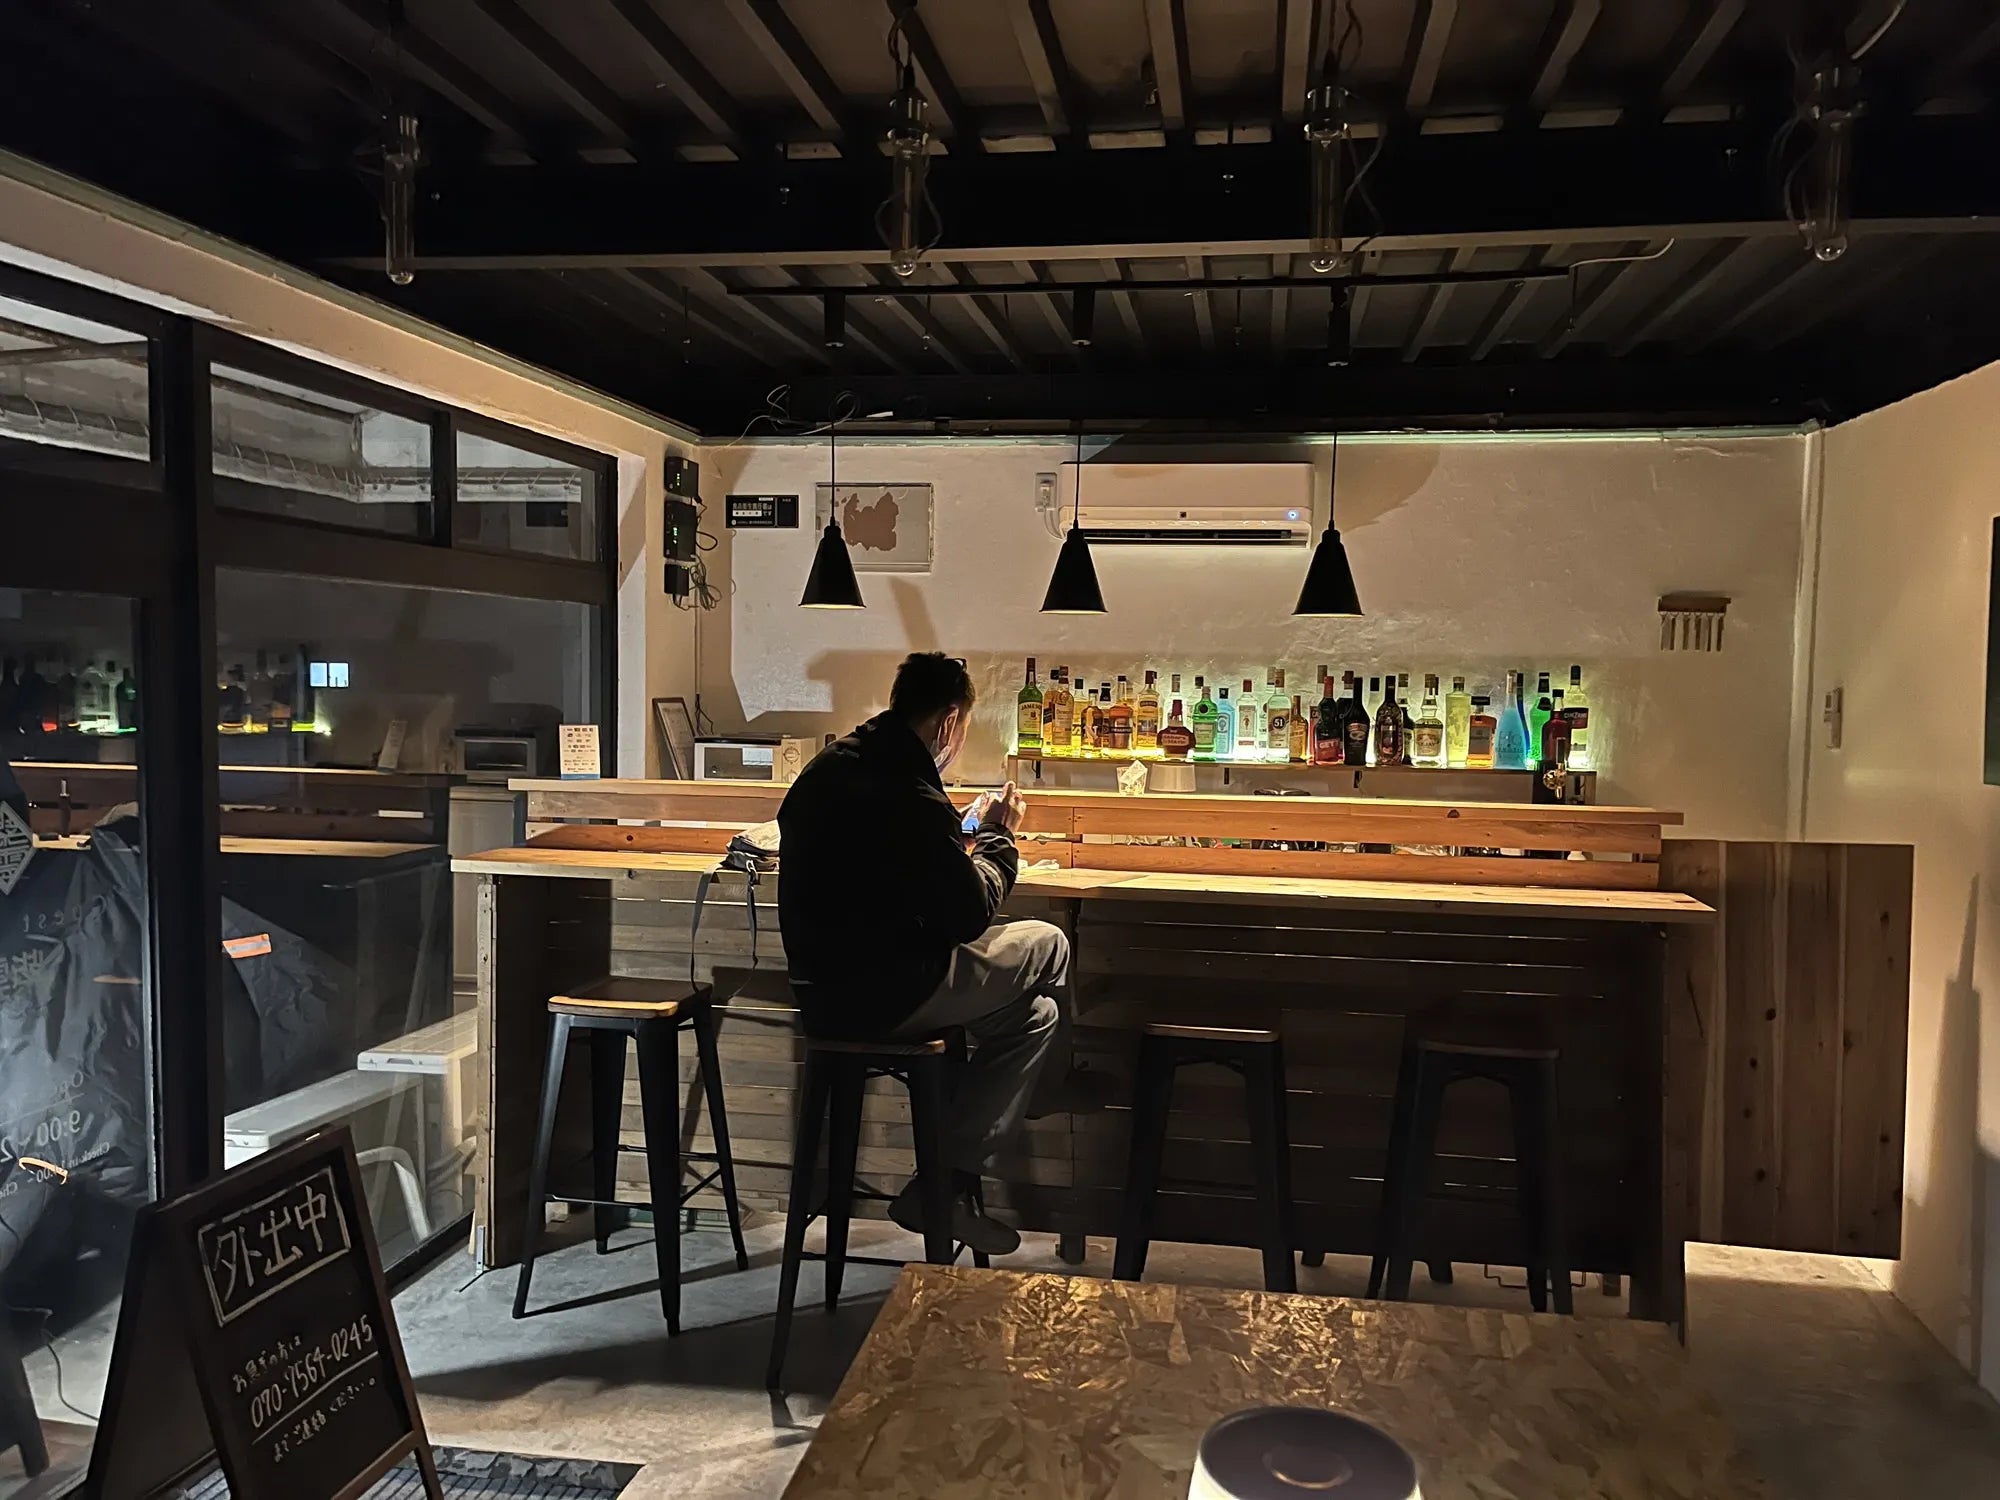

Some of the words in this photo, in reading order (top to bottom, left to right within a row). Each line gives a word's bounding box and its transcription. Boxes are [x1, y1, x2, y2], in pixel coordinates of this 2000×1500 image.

[1273, 718, 1284, 728] 51
[213, 1184, 328, 1303] 外出中
[250, 1313, 374, 1429] 070-7564-0245
